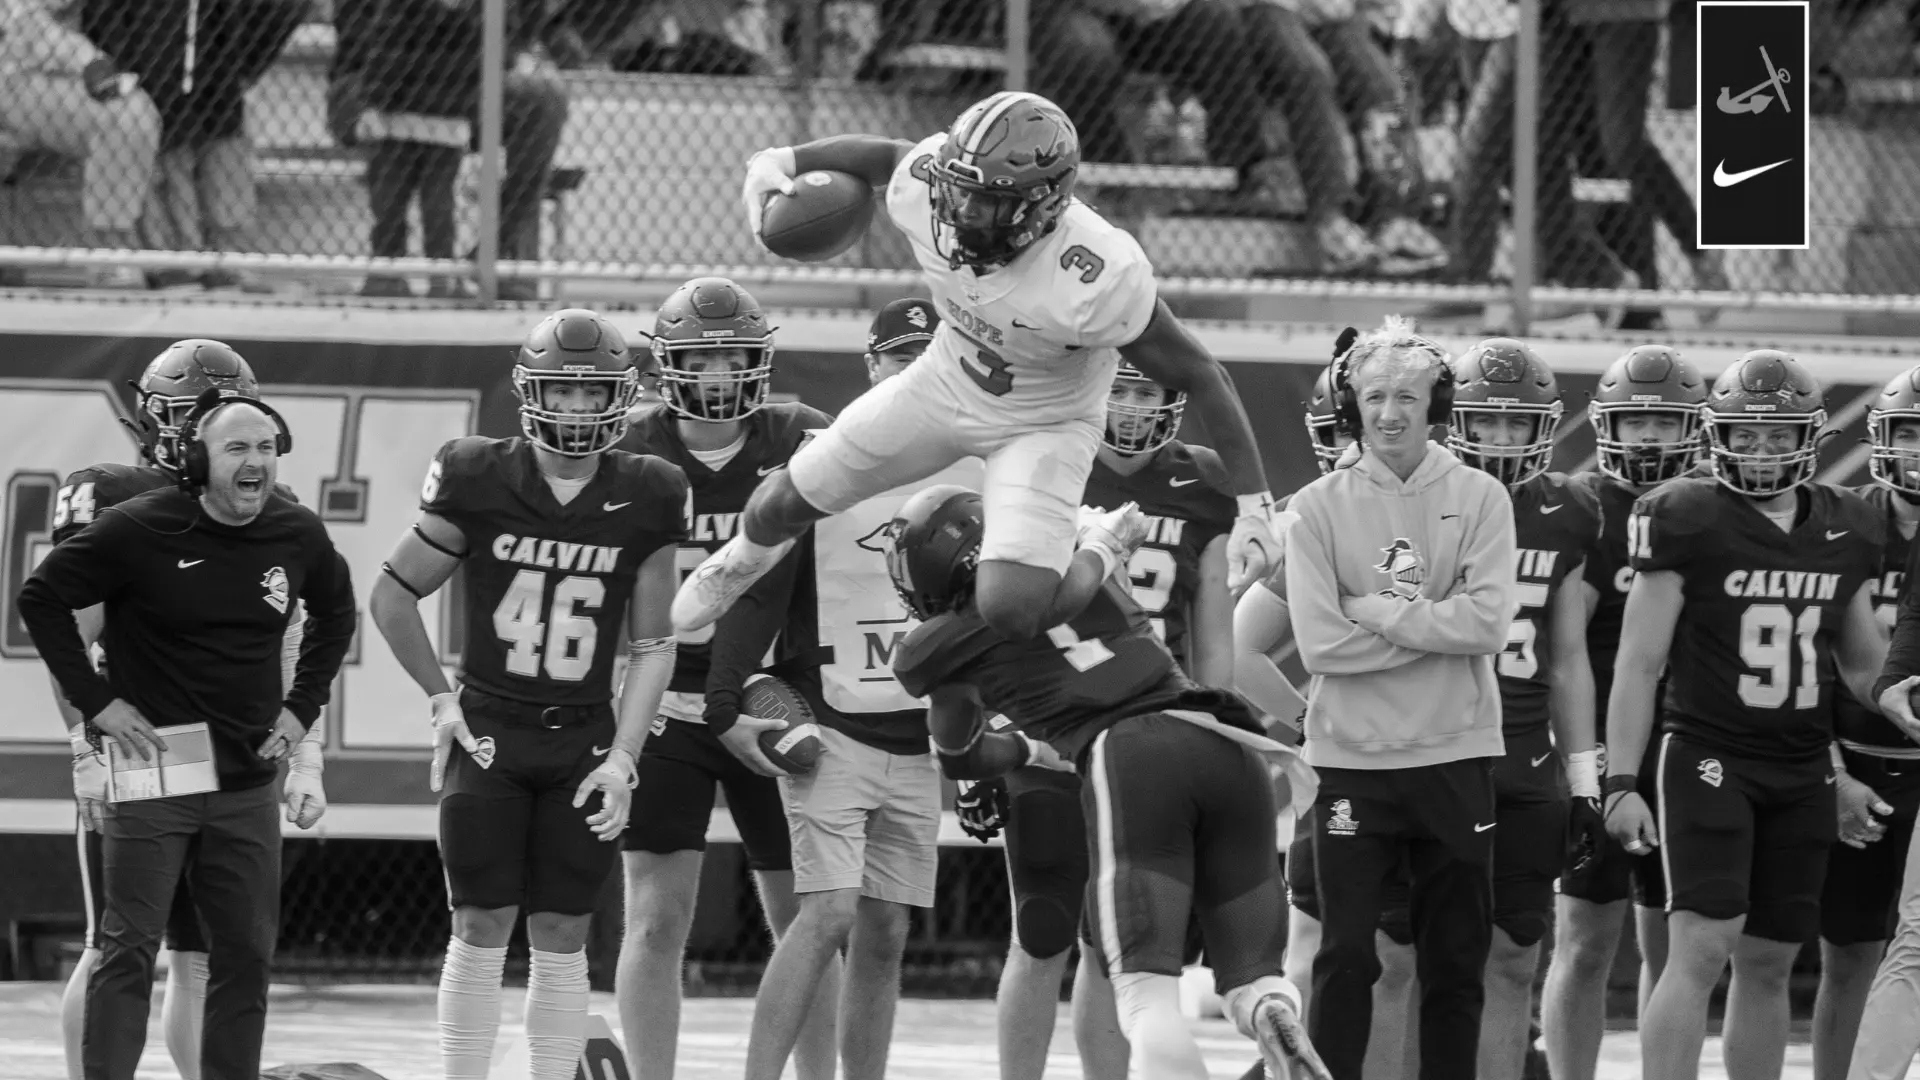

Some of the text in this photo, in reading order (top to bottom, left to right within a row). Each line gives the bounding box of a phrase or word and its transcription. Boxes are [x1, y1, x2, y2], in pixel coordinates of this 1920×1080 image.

[1060, 244, 1104, 284] 3
[947, 297, 1003, 346] HOPE
[53, 482, 96, 528] 54
[492, 533, 623, 573] CALVIN
[1627, 513, 1652, 558] 91
[1724, 569, 1842, 600] CALVIN
[492, 568, 606, 681] 46
[1737, 603, 1822, 710] 91
